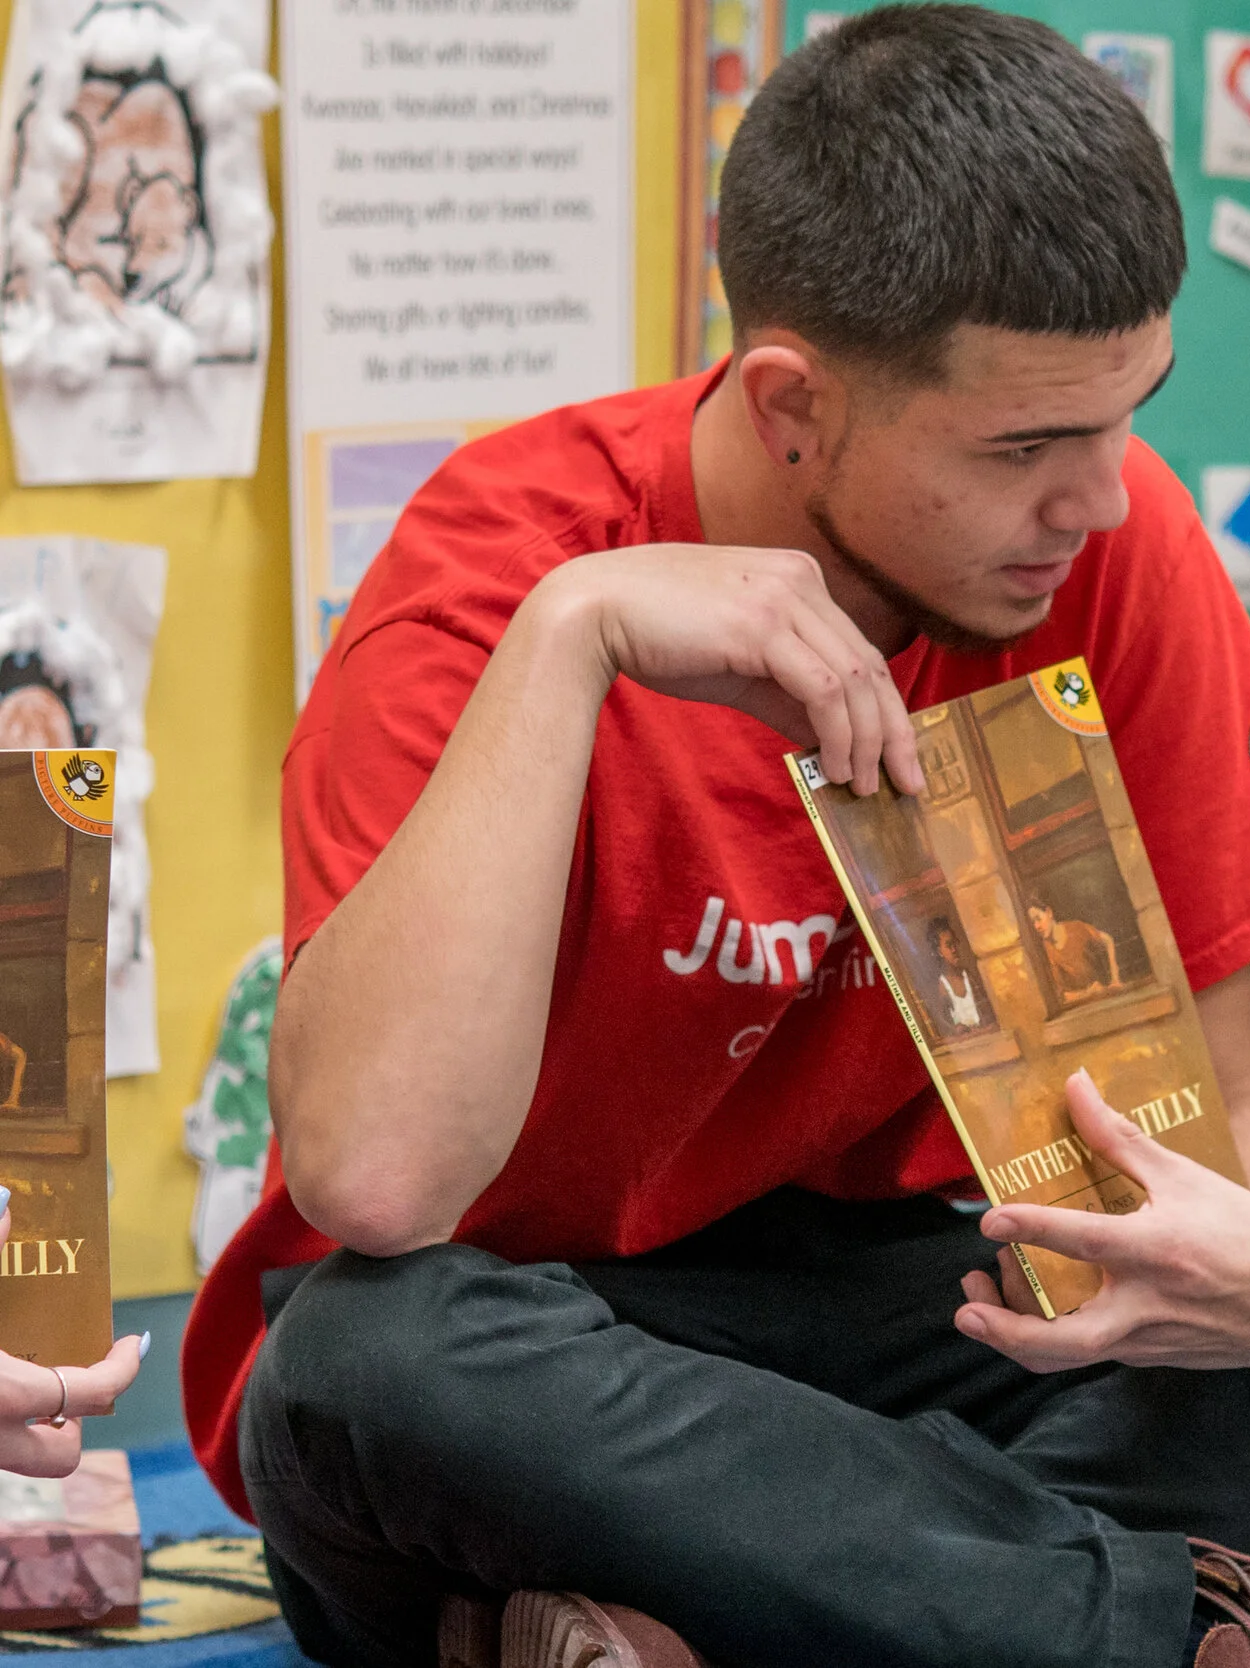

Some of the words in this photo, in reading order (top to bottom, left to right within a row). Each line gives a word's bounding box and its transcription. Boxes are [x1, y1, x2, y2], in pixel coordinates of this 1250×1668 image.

[37, 759, 58, 805] PICTURE
[60, 807, 104, 834] PUFFINS
[663, 897, 857, 986] Jum
[884, 967, 904, 1005] MATTHEW
[901, 1006, 913, 1022] AND
[911, 1023, 923, 1044] TILLY
[1130, 1083, 1205, 1138] TILLY
[0, 1238, 85, 1277] ILLY
[1013, 1242, 1028, 1266] UFFIN
[1025, 1266, 1042, 1294] BOOKS
